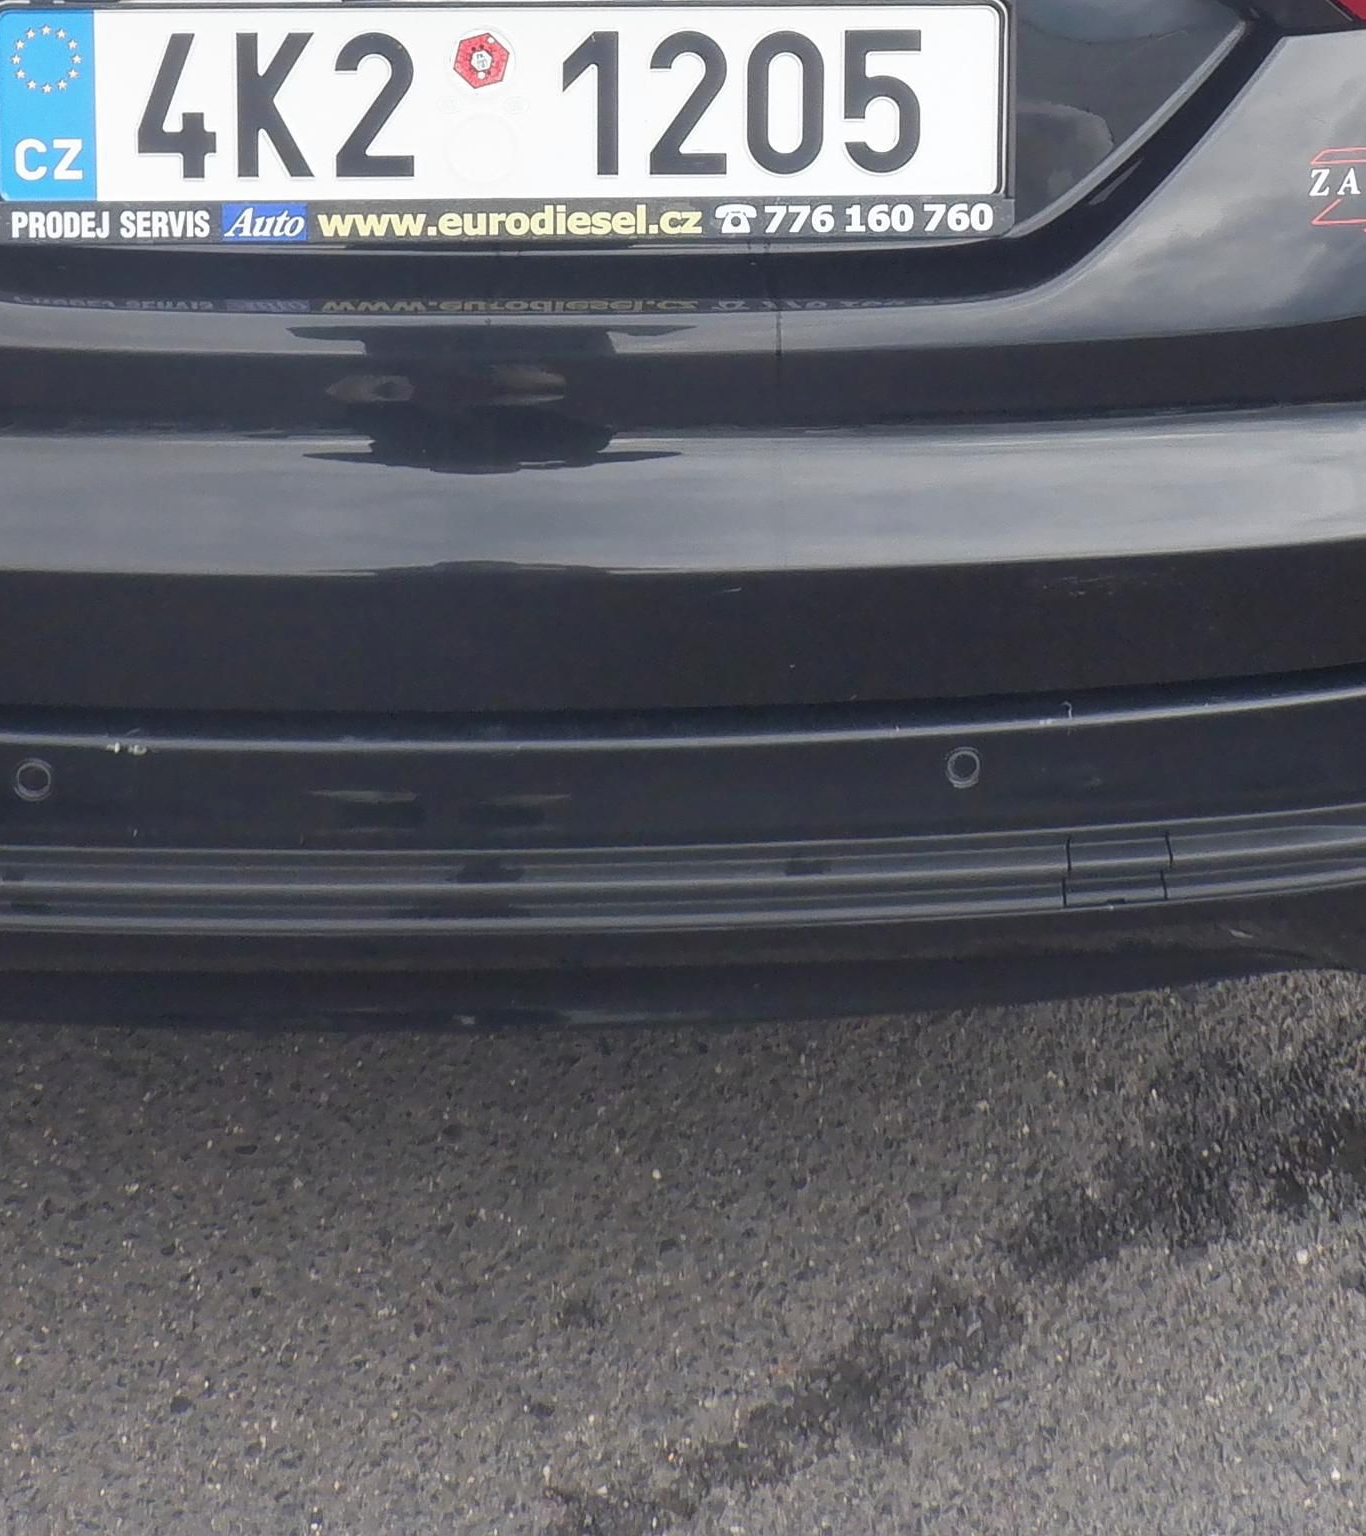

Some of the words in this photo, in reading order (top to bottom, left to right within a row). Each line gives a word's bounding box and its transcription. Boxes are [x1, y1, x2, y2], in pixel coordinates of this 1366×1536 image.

[136, 31, 416, 180] 4K2
[561, 28, 922, 176] 1205
[13, 137, 84, 181] CZ
[11, 210, 111, 240] PRODEJ
[119, 209, 211, 239] SERVIS
[223, 207, 307, 238] Auto
[318, 204, 704, 238] www.eurodiesel.cz
[763, 204, 836, 233] 776
[844, 204, 915, 232] 160
[923, 203, 995, 232] 760
